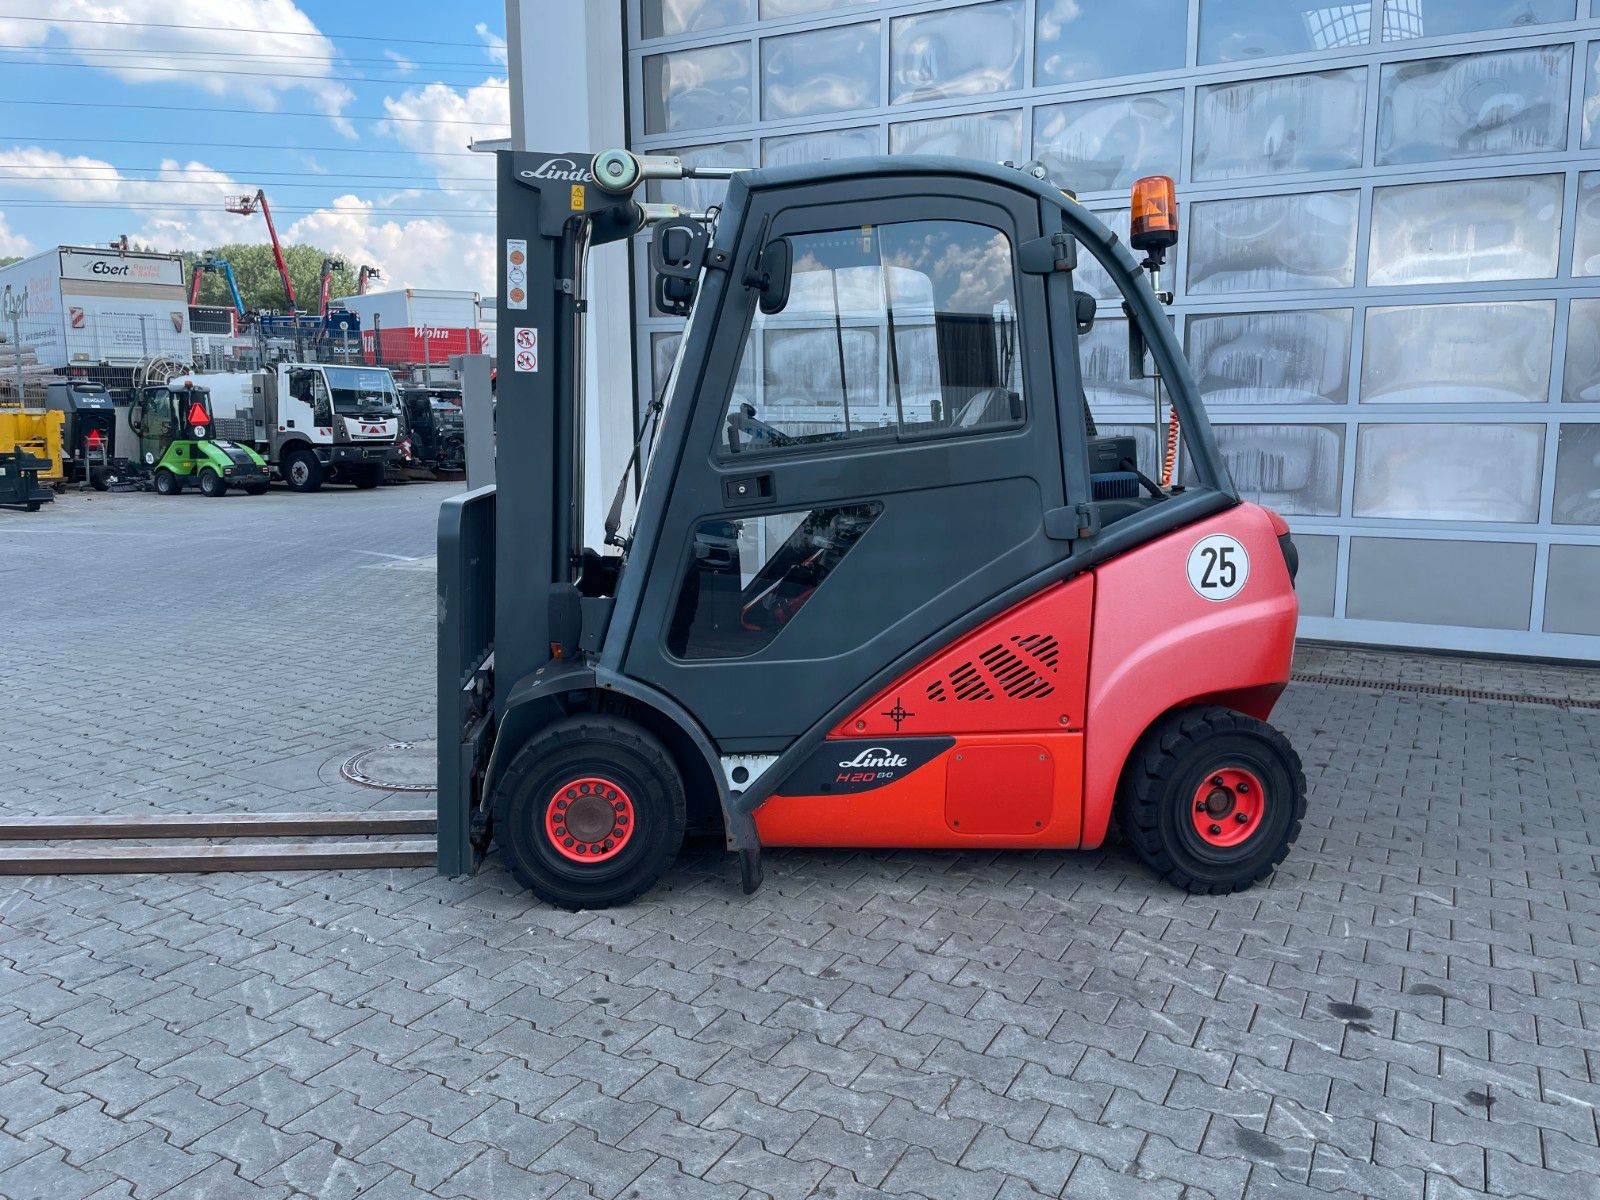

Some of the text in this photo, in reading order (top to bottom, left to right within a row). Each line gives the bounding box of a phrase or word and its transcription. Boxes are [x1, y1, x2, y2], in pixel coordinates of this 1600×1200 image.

[520, 158, 594, 183] Linde
[92, 261, 129, 276] Ebert
[414, 327, 449, 339] Wohn
[1200, 547, 1236, 588] 25
[838, 747, 908, 768] Linde
[876, 771, 893, 779] EVO
